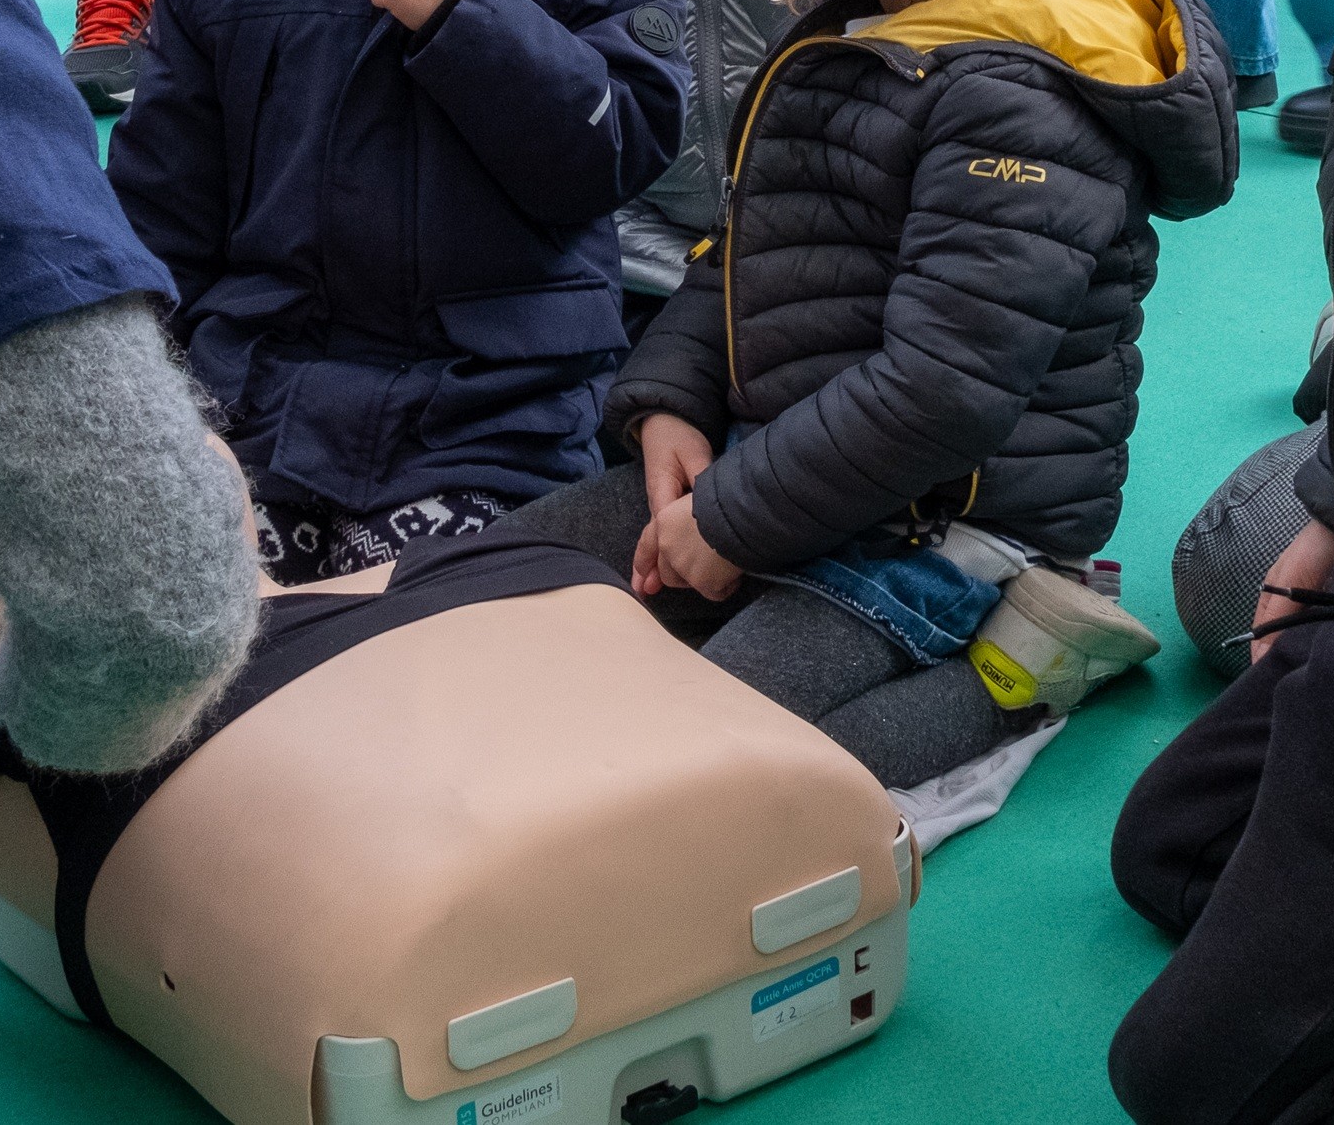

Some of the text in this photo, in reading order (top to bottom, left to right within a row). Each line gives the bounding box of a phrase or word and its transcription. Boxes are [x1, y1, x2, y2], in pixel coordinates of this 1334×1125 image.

[968, 157, 1046, 183] CMP
[981, 661, 1015, 691] MUNICH
[758, 963, 833, 1006] Little Anne QCPR
[481, 1082, 553, 1118] Guidelines
